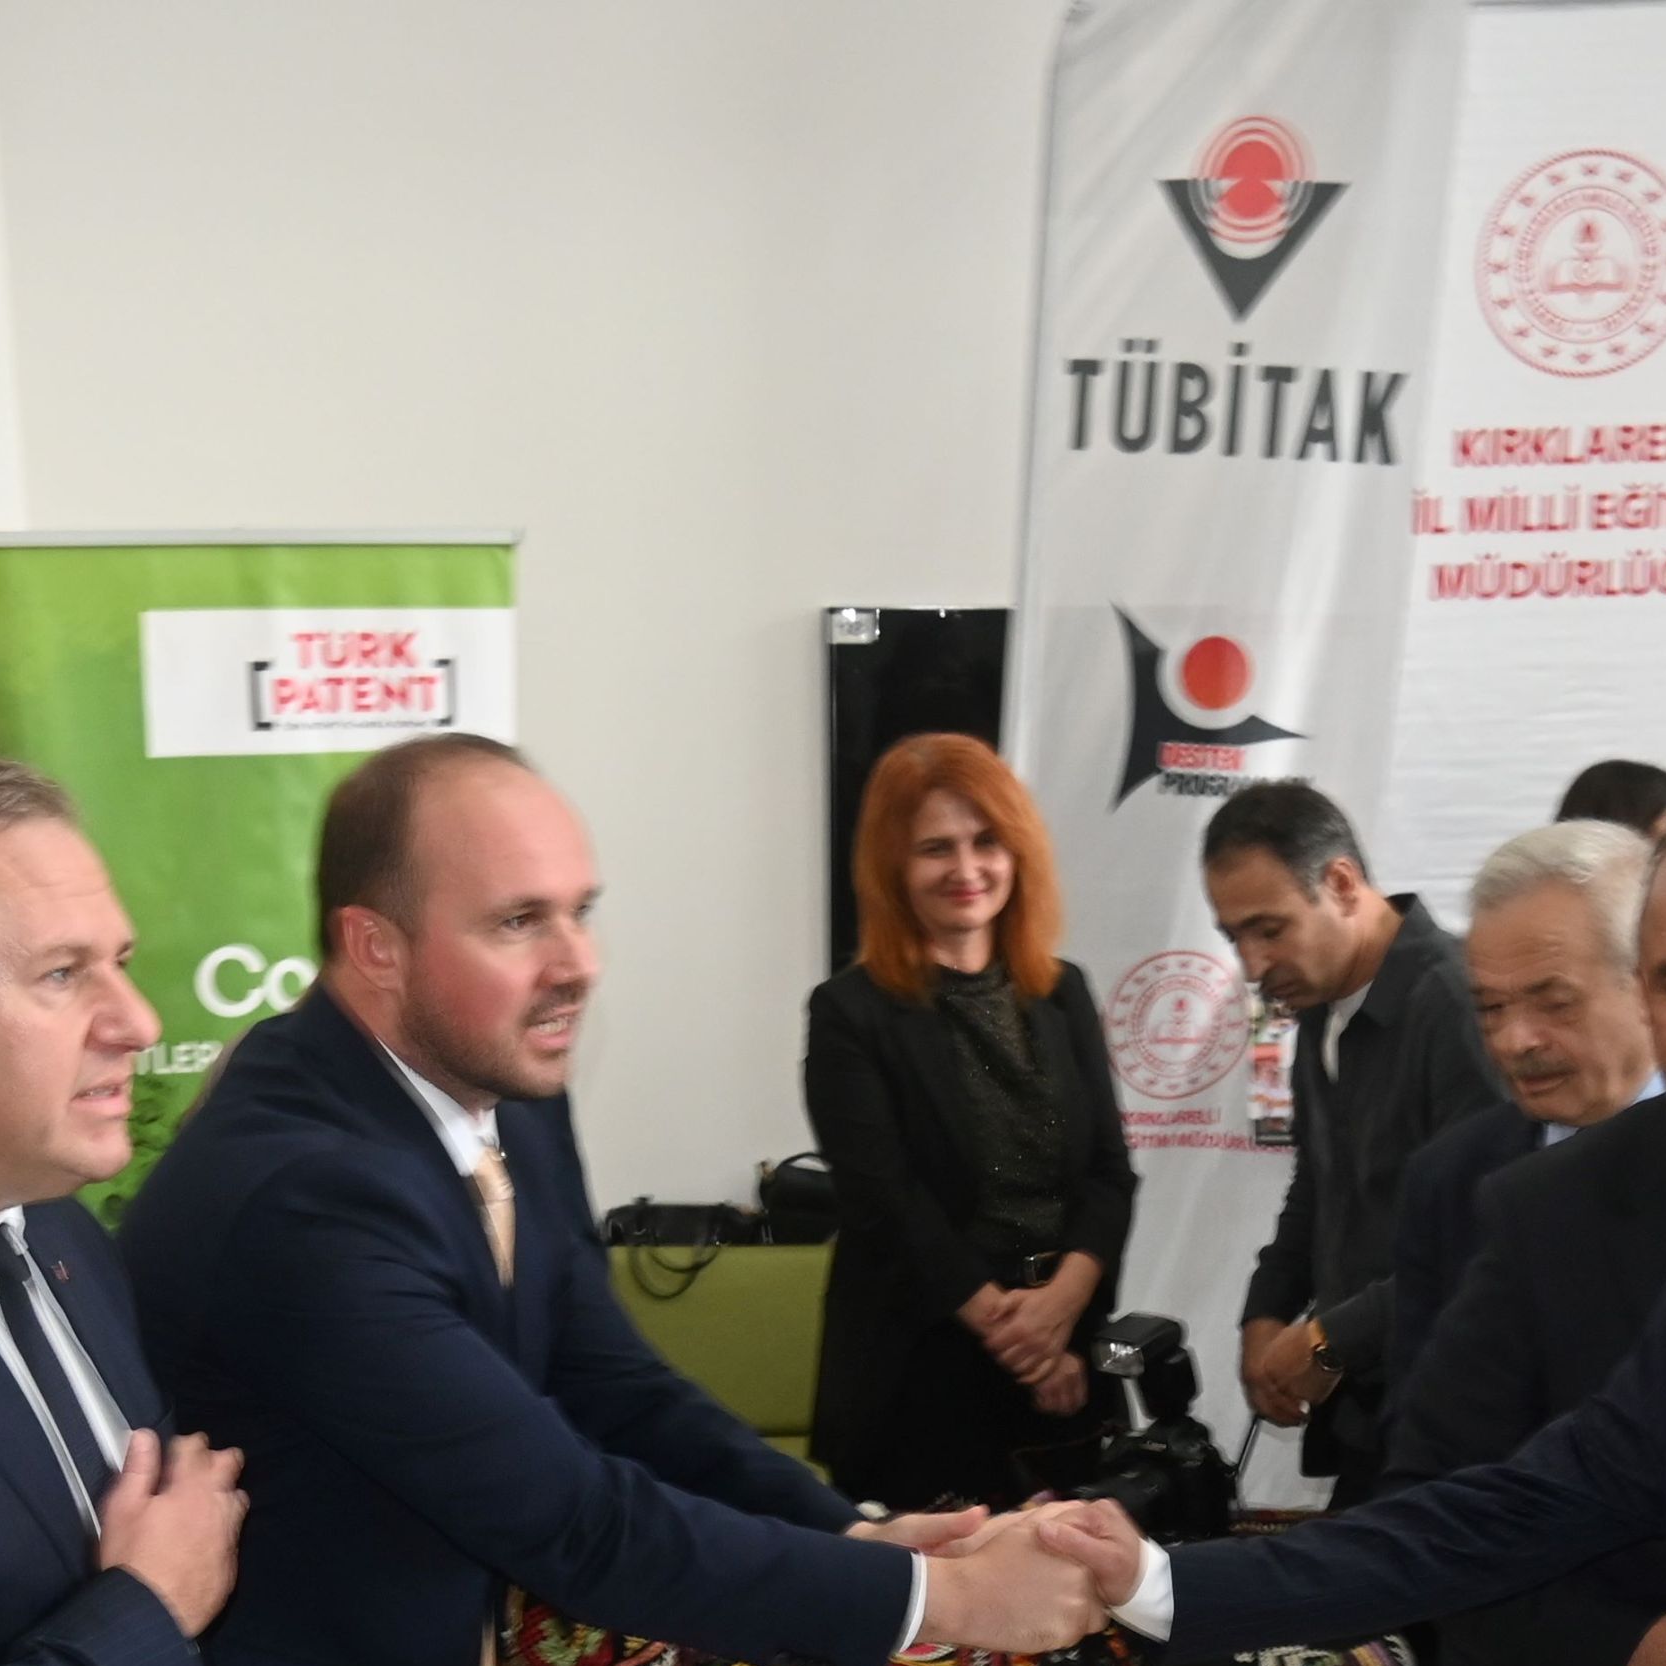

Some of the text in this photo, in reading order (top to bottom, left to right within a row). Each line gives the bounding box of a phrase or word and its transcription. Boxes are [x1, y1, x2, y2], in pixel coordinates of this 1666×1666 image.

[1064, 337, 1410, 467] TÜBİTAK
[1410, 488, 1452, 535] İL
[1457, 484, 1582, 534] MİLLİ
[271, 675, 441, 715] PATENT
[195, 942, 319, 1018] Co
